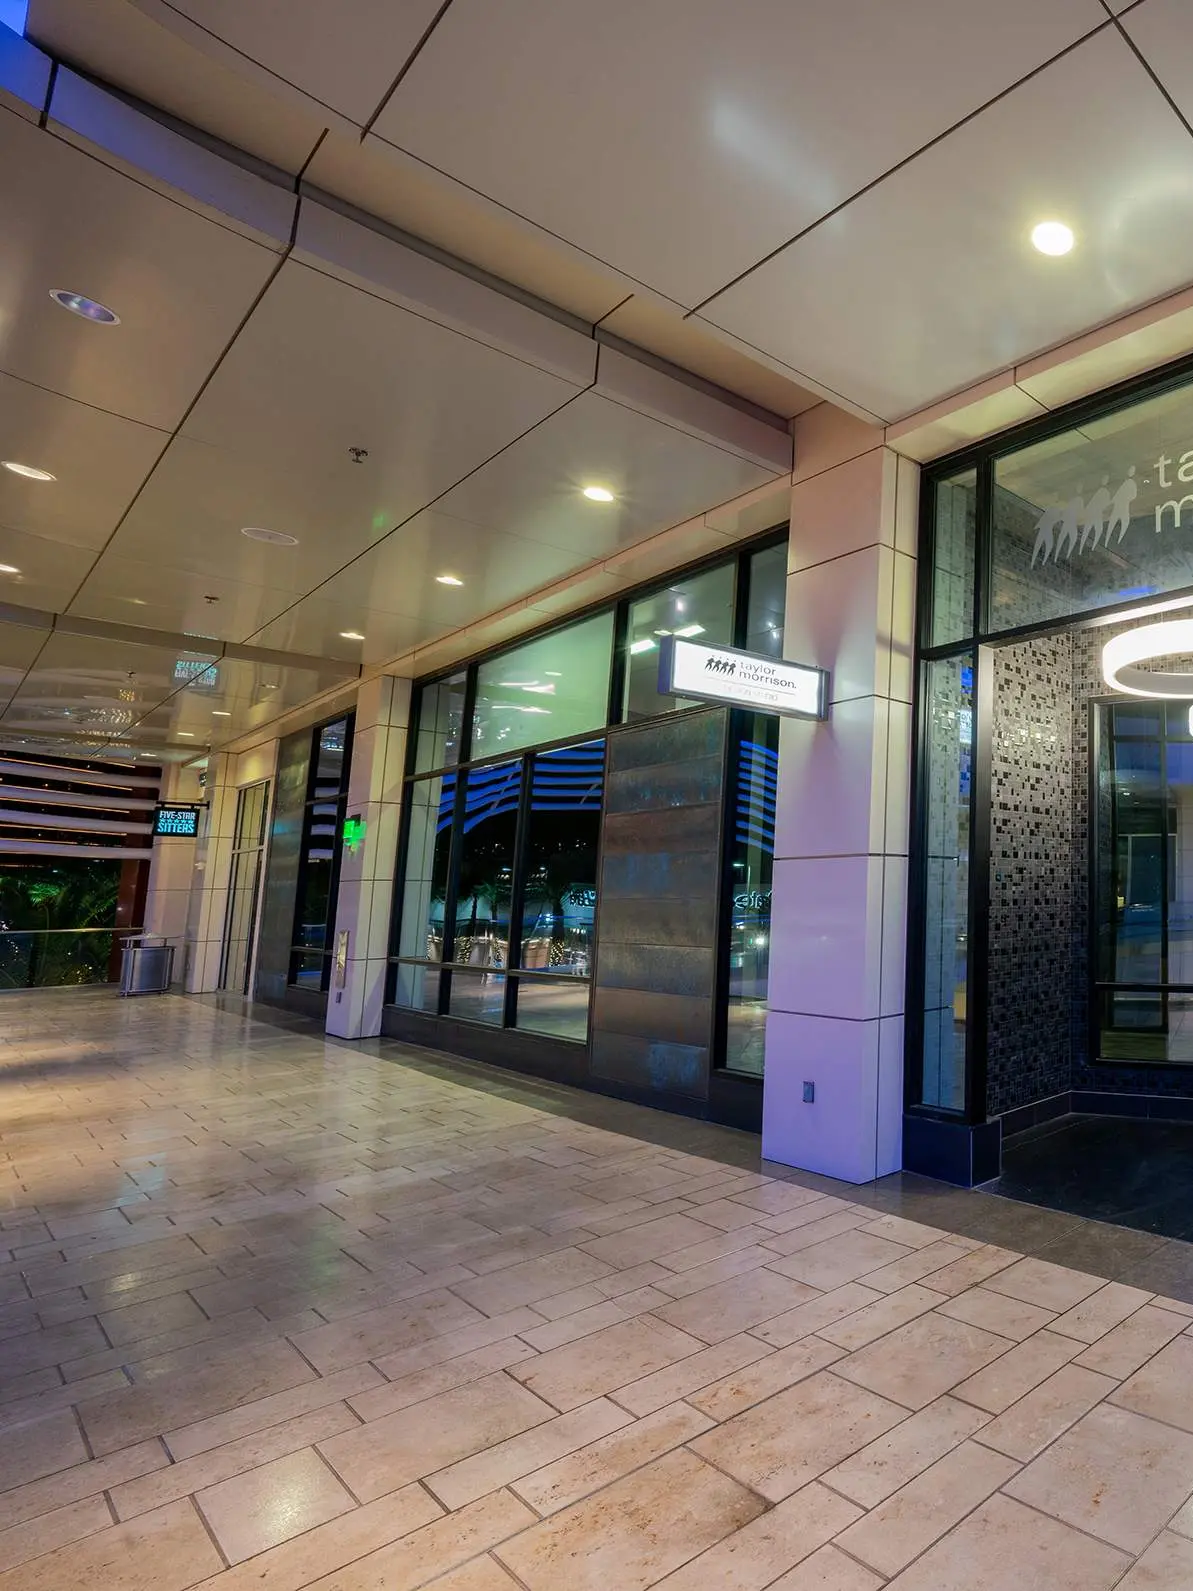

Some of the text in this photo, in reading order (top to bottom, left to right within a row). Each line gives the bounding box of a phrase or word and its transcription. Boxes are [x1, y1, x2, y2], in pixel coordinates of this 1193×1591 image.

[740, 661, 776, 676] taylor
[160, 810, 196, 820] FIVE-STAR
[157, 821, 195, 833] SITTERS
